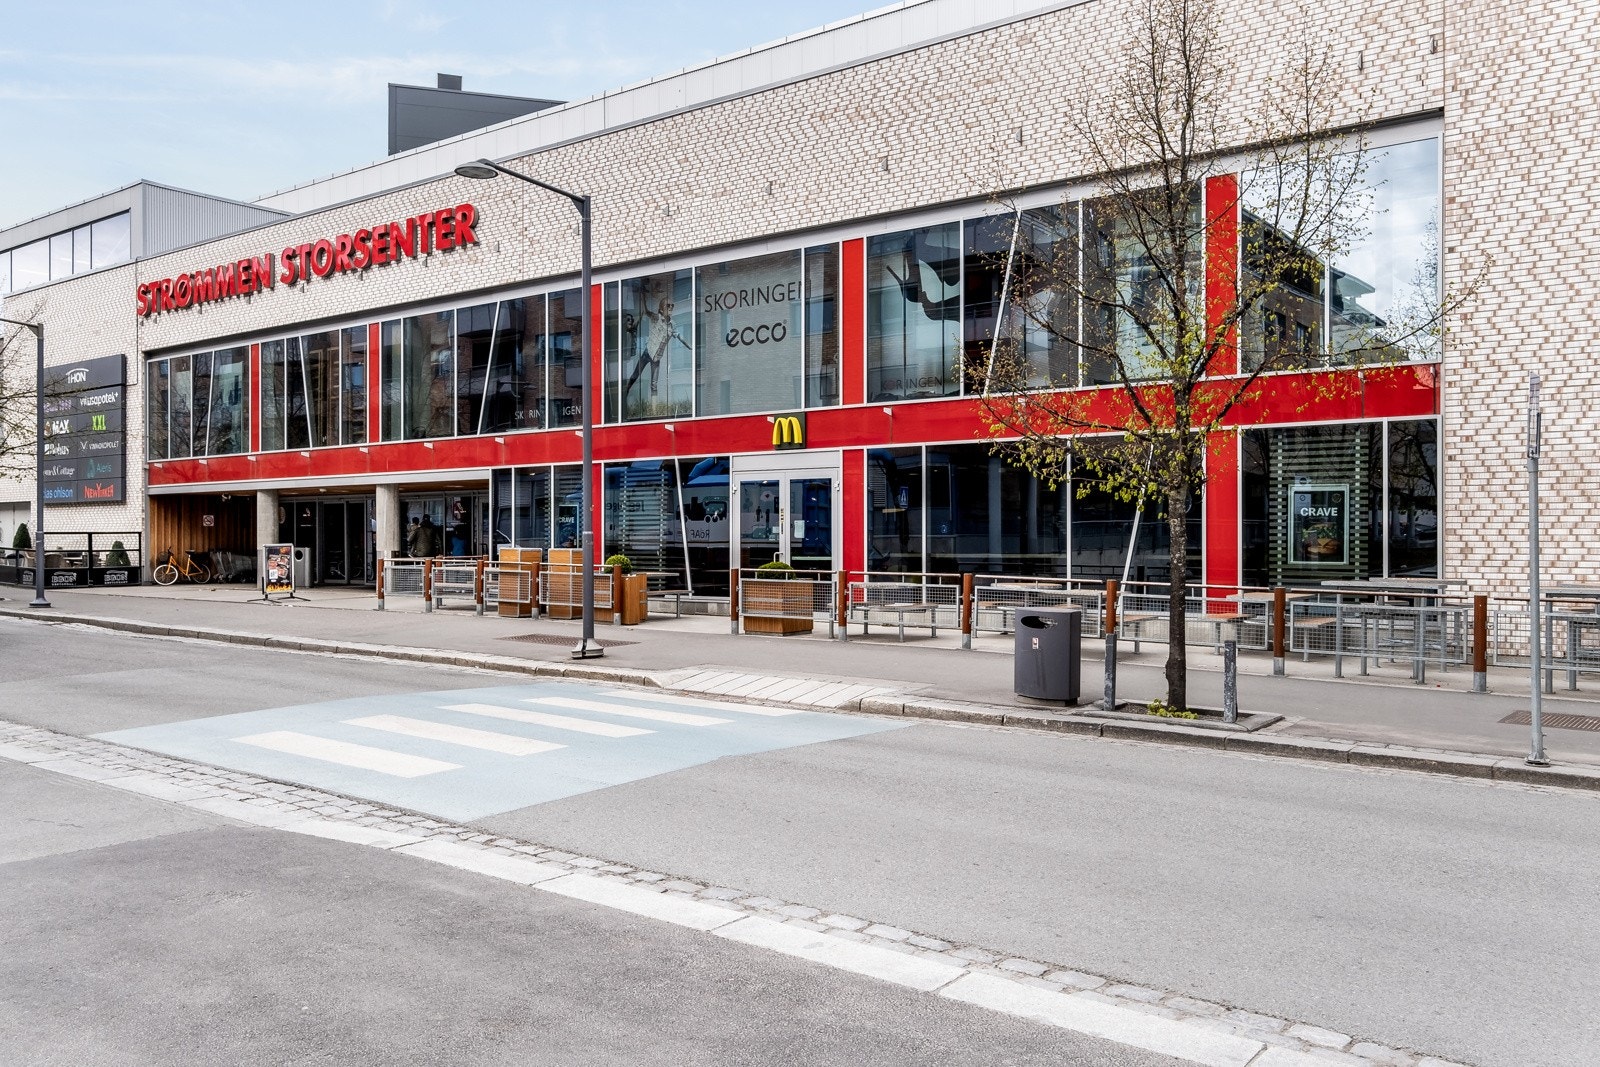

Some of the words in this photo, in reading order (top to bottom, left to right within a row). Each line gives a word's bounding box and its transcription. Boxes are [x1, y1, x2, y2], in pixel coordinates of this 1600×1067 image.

[137, 253, 275, 317] STRØMMEN
[280, 203, 479, 286] STORSENTER
[726, 322, 787, 347] ecco
[66, 369, 88, 384] THON
[52, 419, 70, 434] MAX
[92, 414, 107, 430] XXL
[1300, 507, 1338, 516] CRAVE
